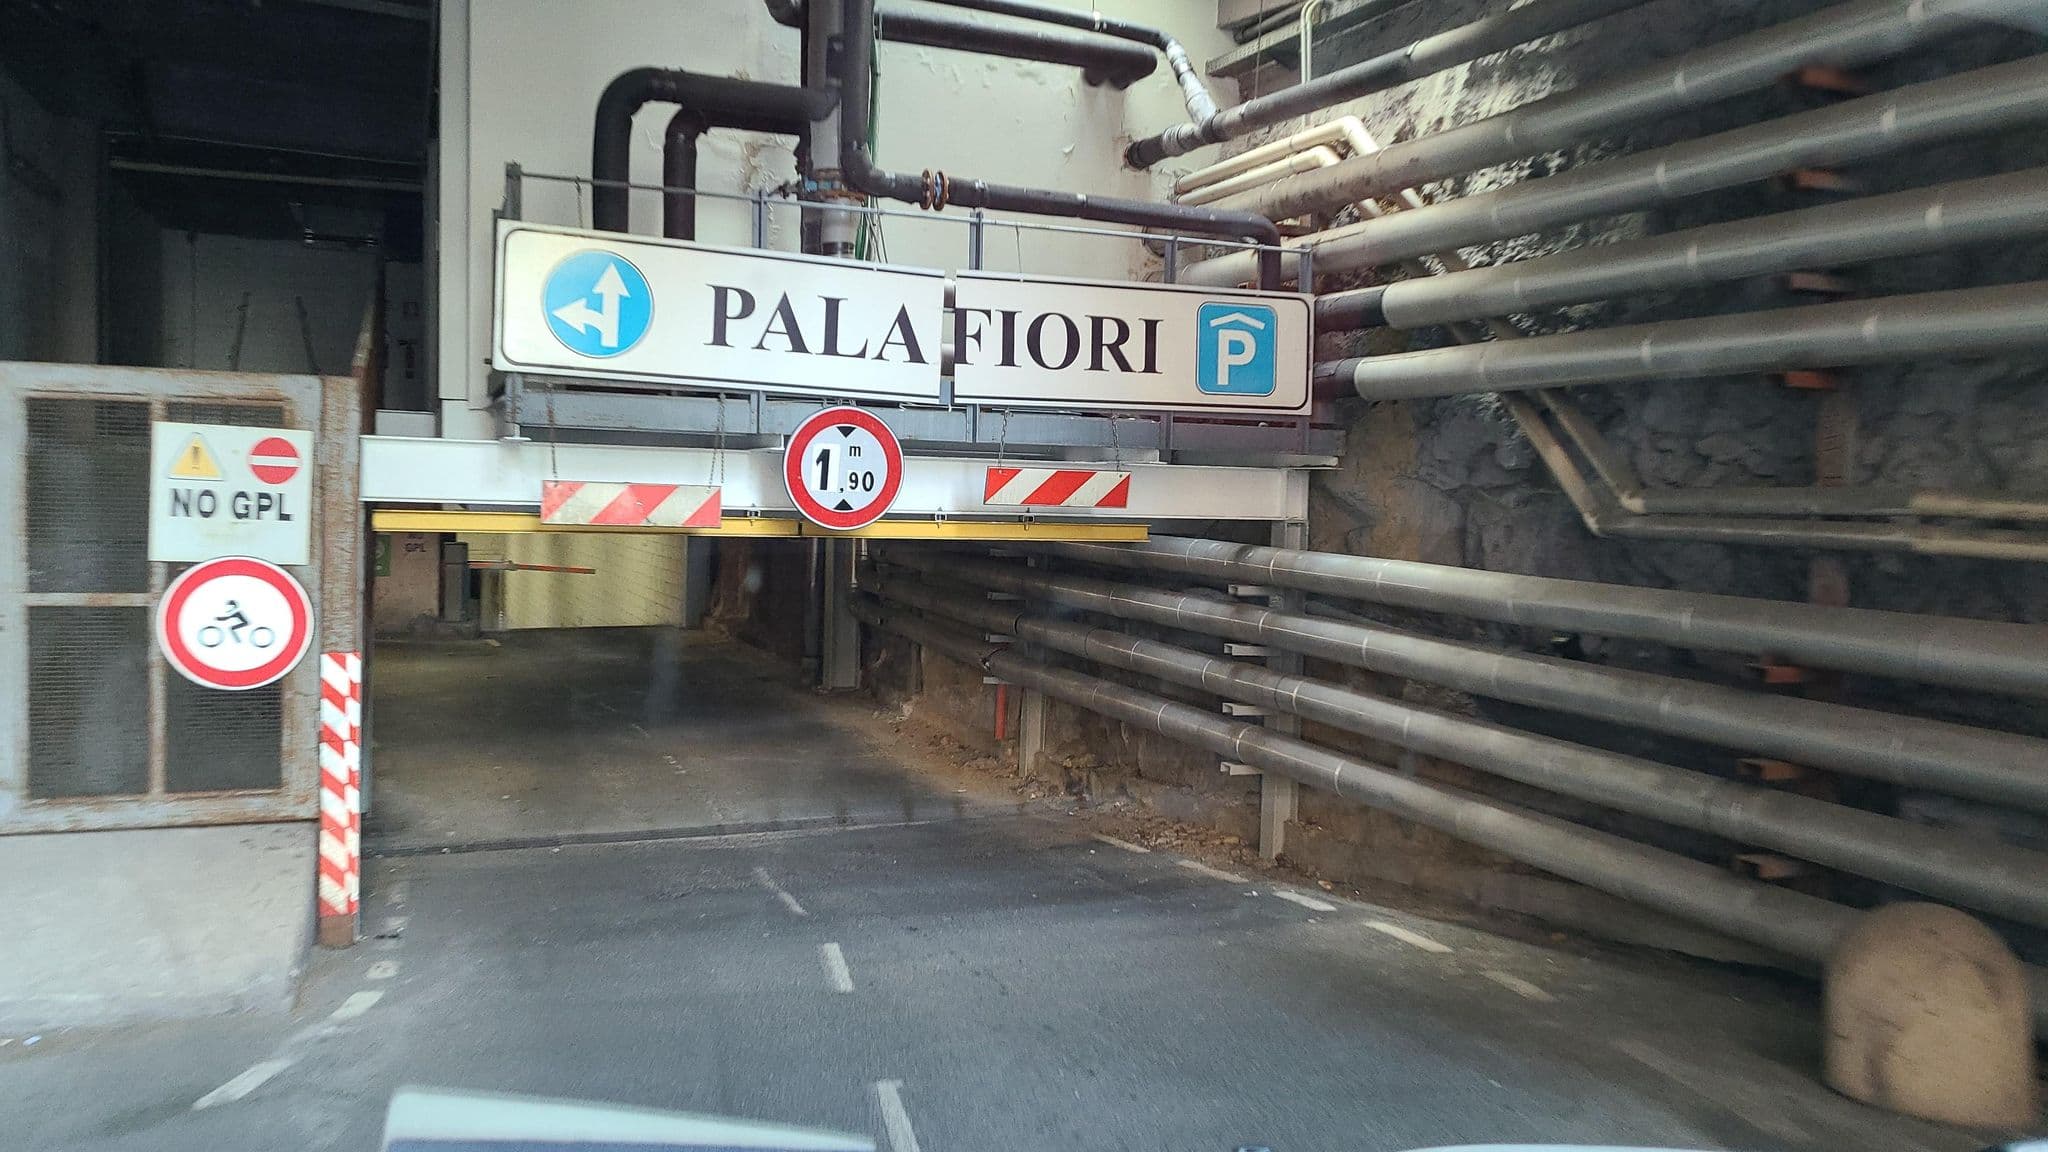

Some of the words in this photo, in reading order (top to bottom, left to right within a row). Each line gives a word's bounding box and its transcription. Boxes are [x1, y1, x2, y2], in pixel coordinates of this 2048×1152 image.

[1217, 327, 1256, 385] P
[849, 445, 862, 457] m
[170, 488, 217, 519] NO
[232, 490, 295, 522] GPL
